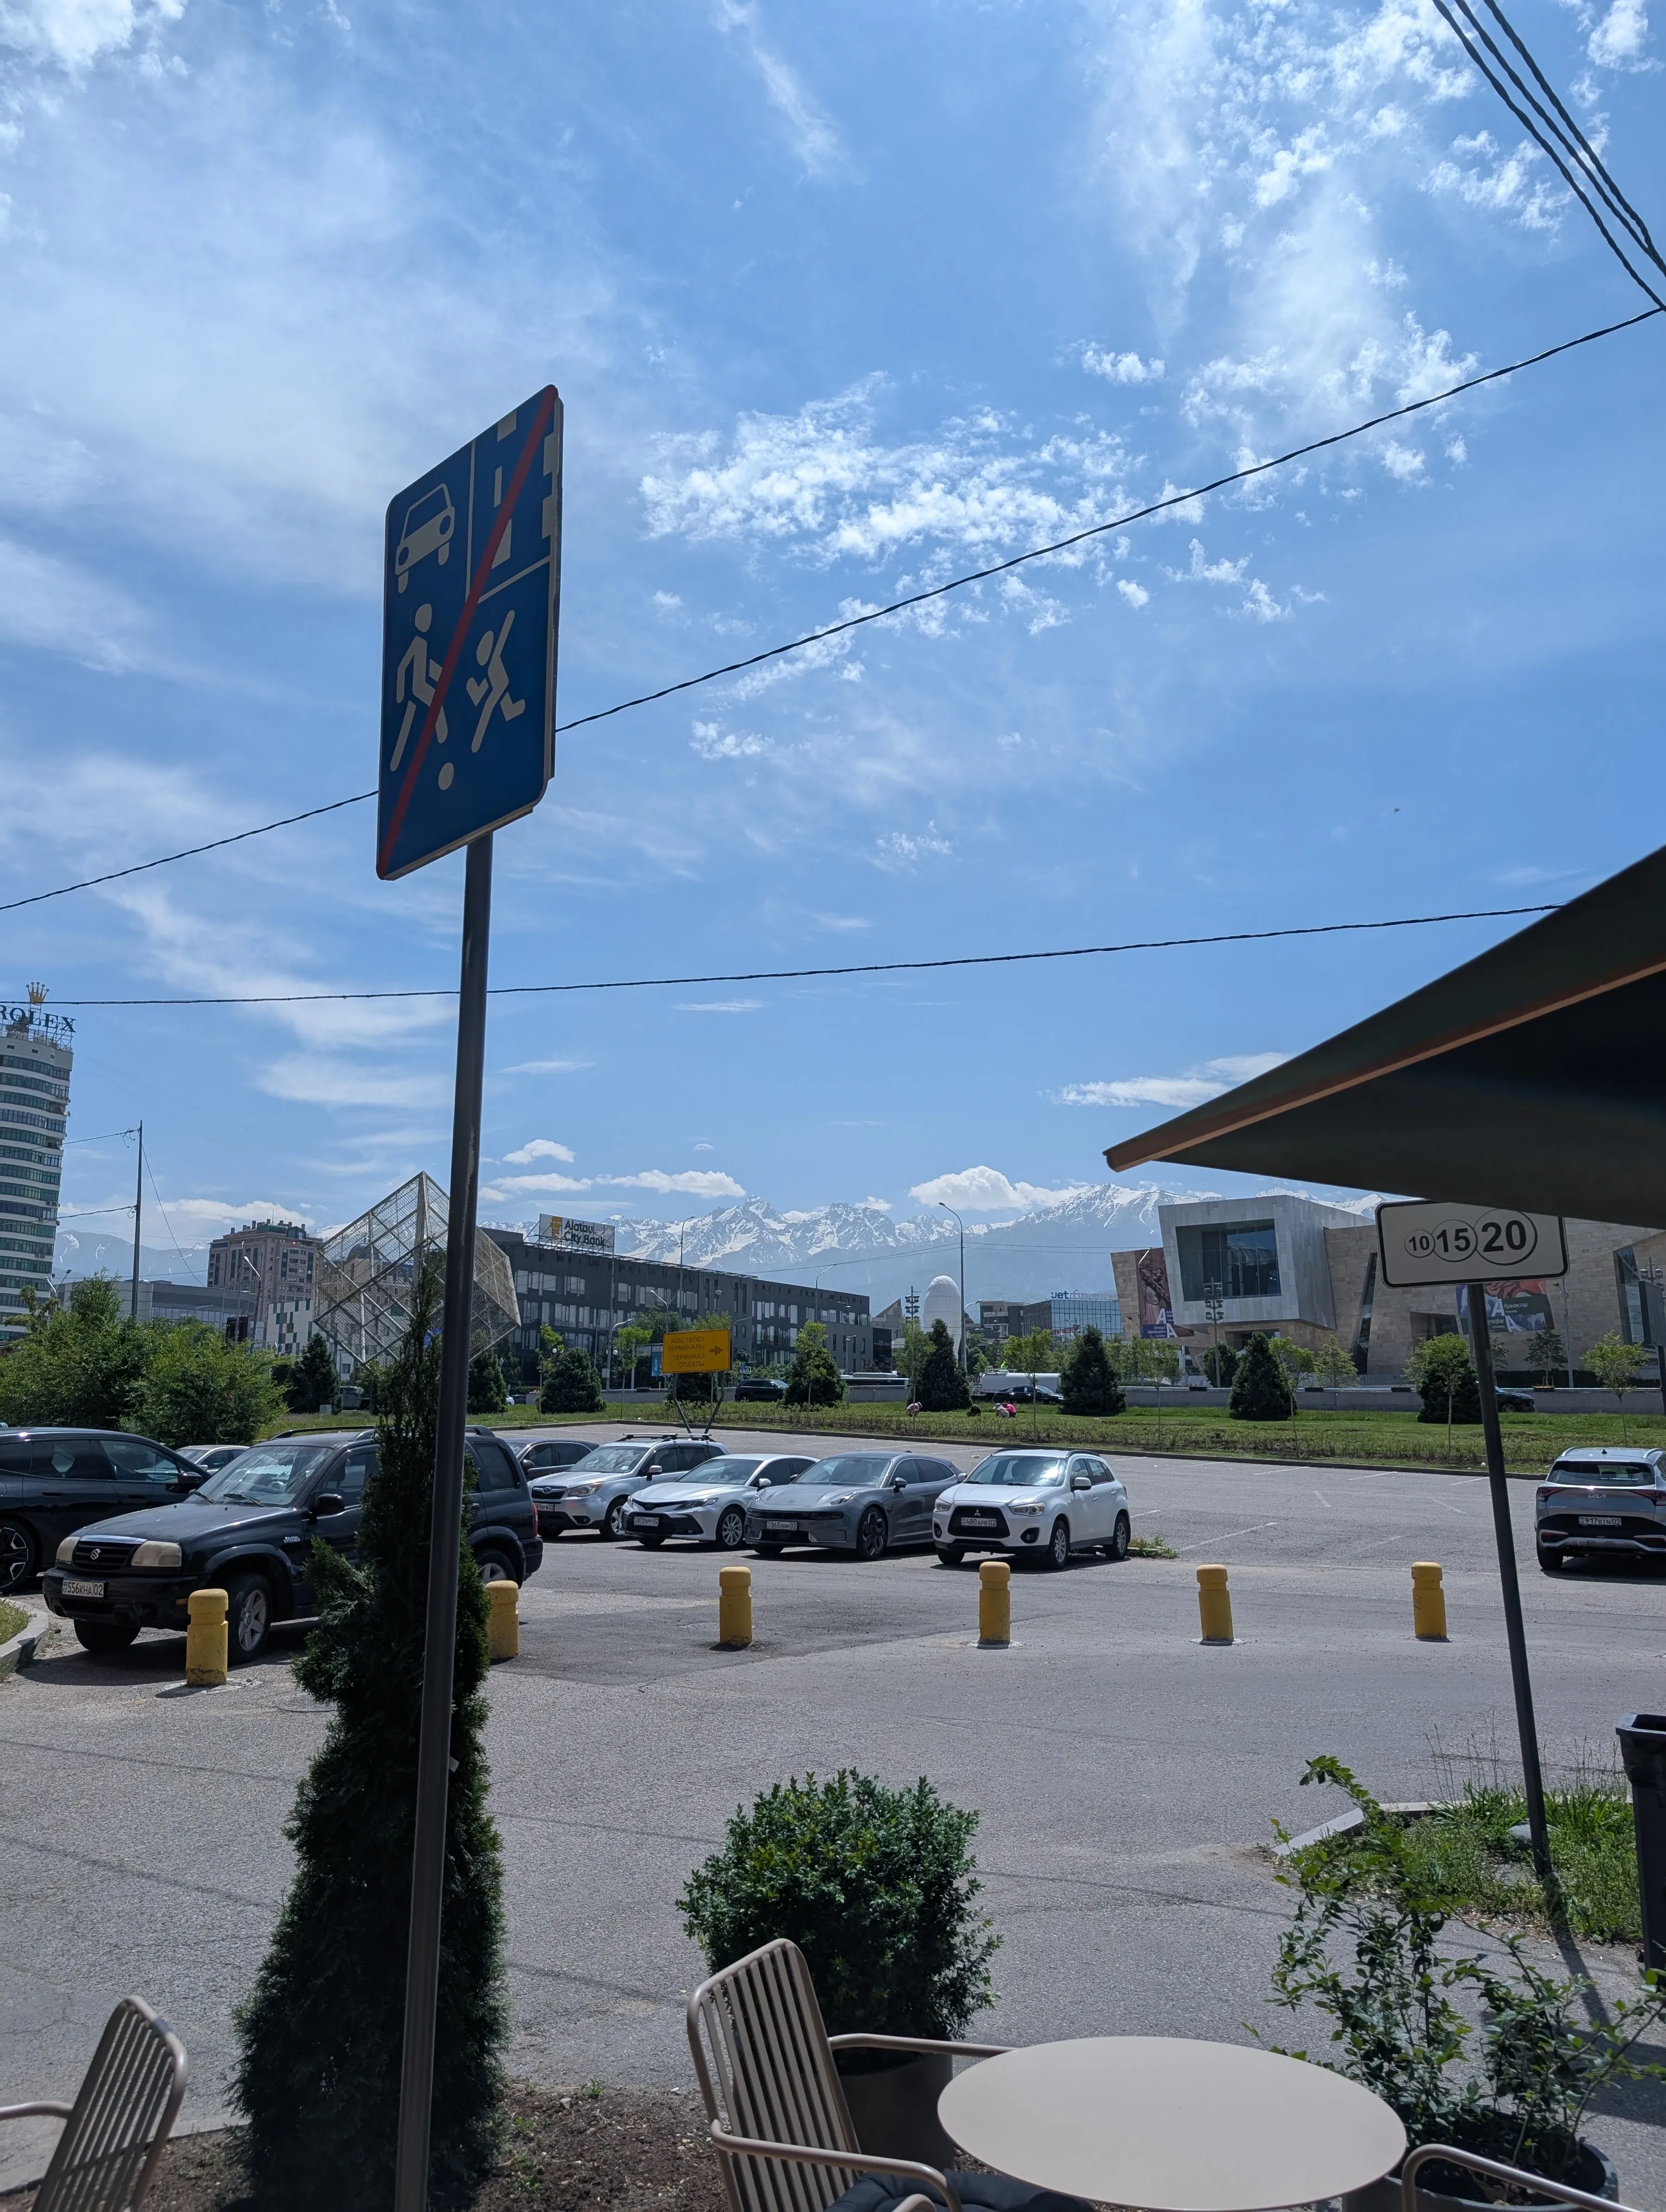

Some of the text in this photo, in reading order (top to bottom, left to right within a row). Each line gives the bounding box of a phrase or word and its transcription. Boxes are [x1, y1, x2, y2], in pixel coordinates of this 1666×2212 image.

[565, 1219, 594, 1233] Alatau
[564, 1231, 605, 1246] City Bank
[1408, 1220, 1527, 1253] 10 15 20
[67, 1581, 92, 1596] 556KHA
[93, 1584, 103, 1596] 02
